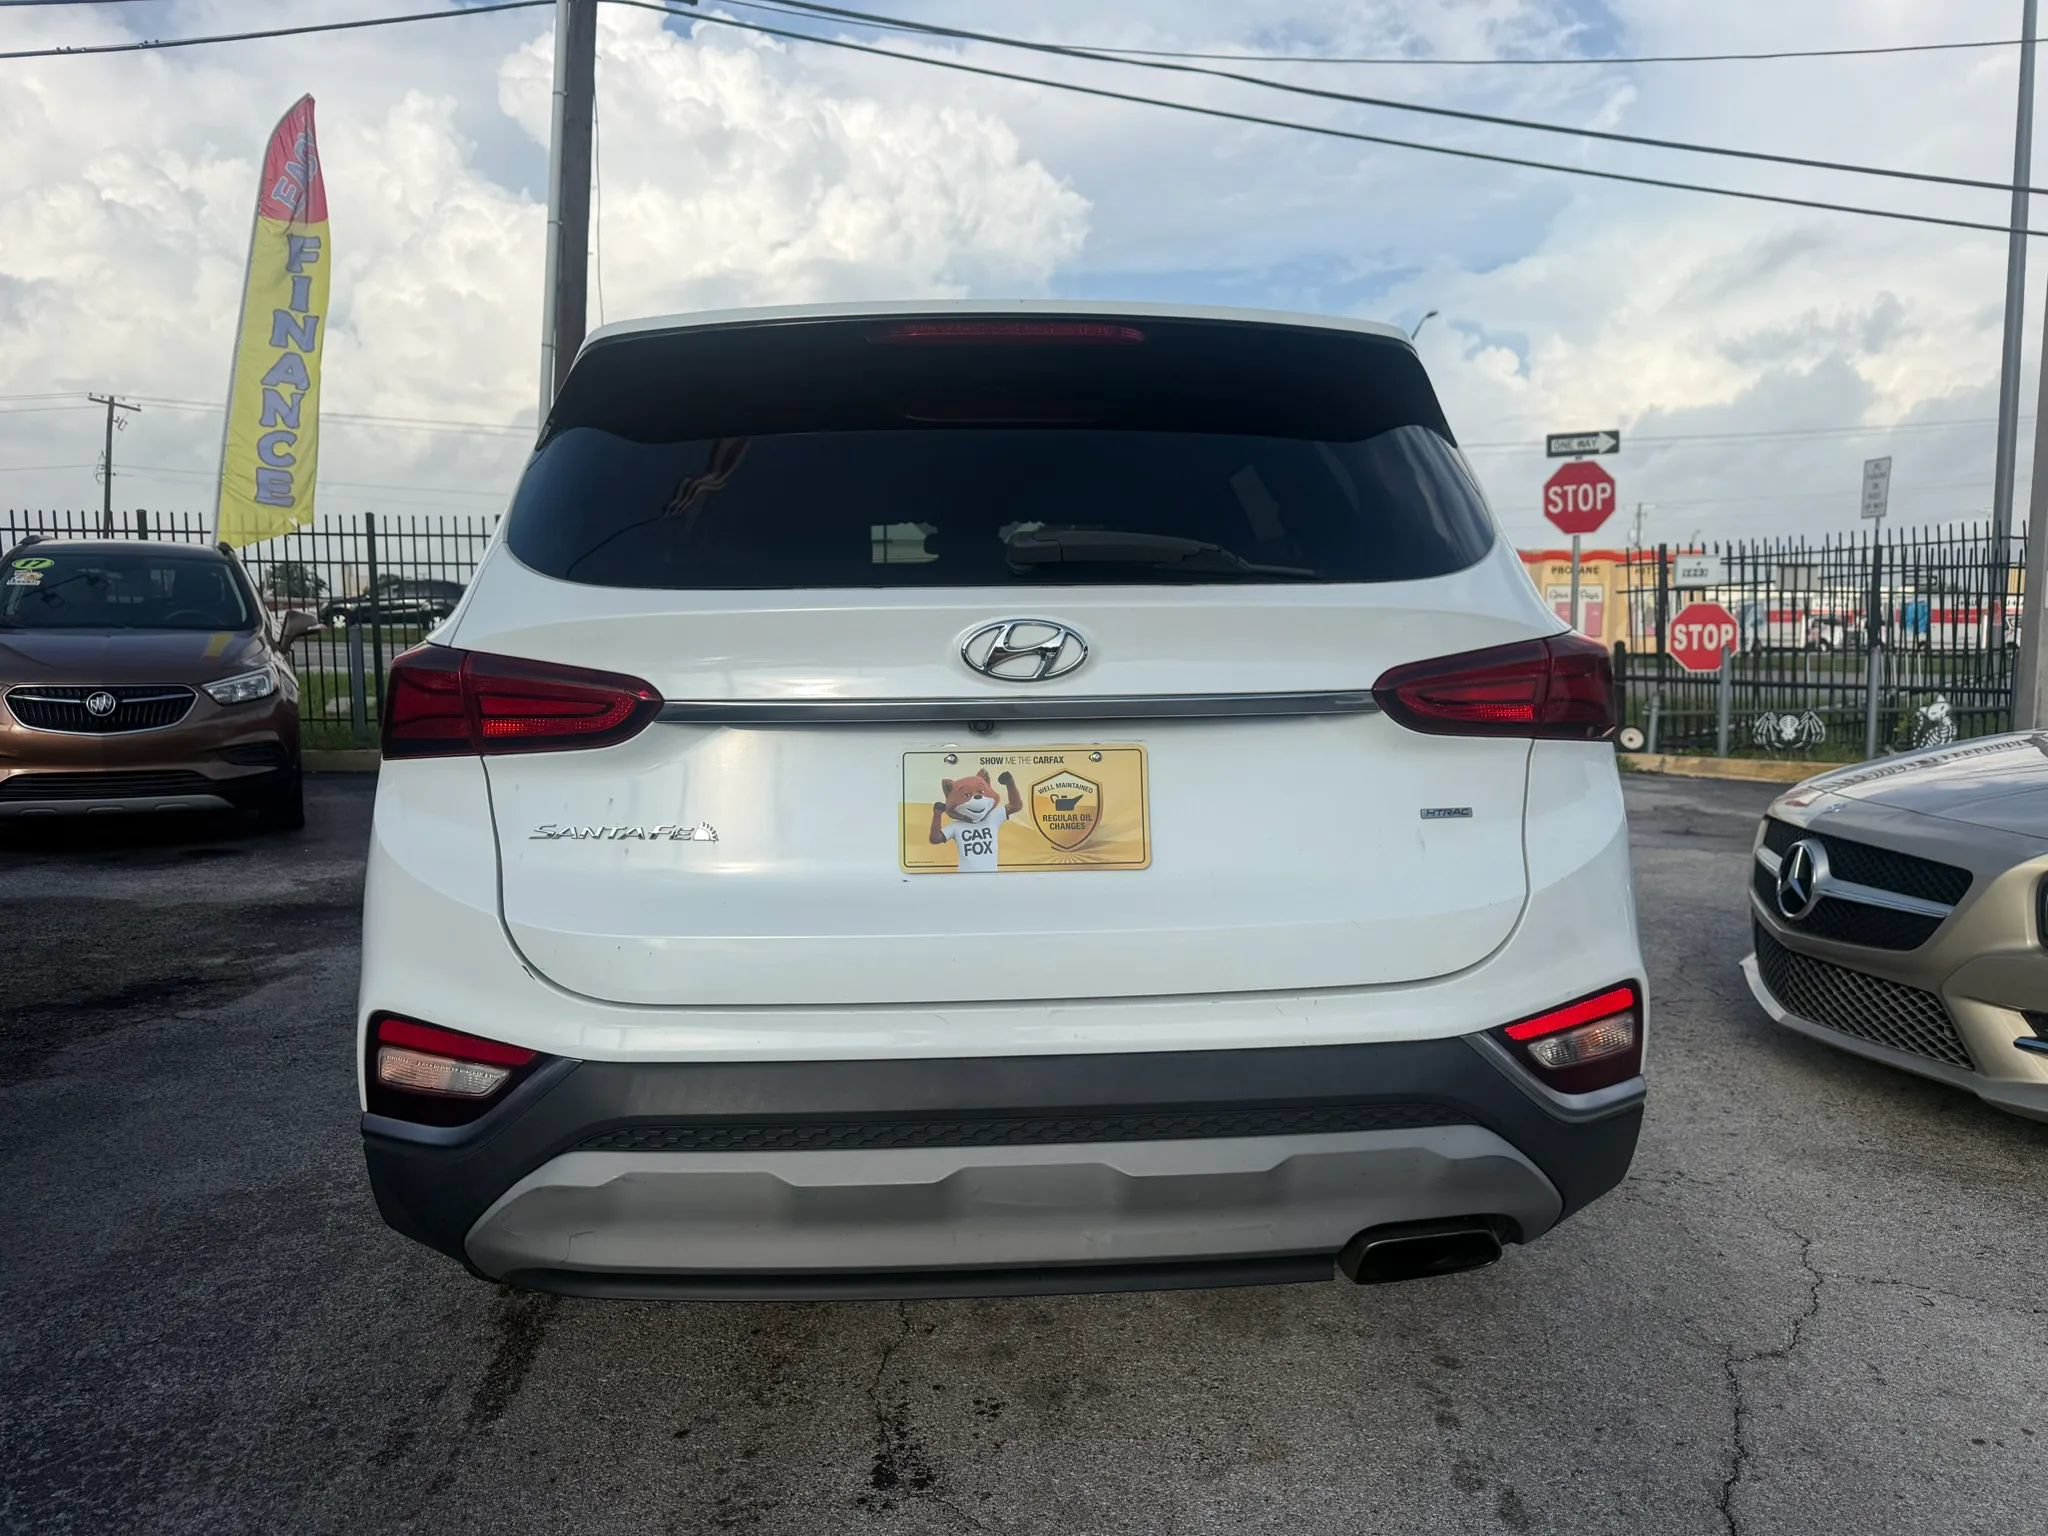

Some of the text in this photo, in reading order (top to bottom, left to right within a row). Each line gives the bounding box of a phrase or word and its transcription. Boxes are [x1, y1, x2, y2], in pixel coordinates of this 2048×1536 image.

[255, 233, 322, 508] FINANCE
[1553, 439, 1597, 450] ONE WAY
[1547, 482, 1612, 514] STOP
[1551, 565, 1600, 575] PROANE
[1673, 623, 1734, 651] STOP
[979, 755, 1065, 765] SHOW ME THE CARFAX
[1037, 782, 1094, 795] WELL MAINTAINED
[1042, 813, 1093, 822] REGULAR OIL
[1426, 808, 1470, 817] HTRAC
[529, 824, 696, 841] SANTA FE
[1050, 822, 1086, 831] CHANGES
[961, 827, 993, 842] CAR
[963, 840, 993, 857] FOX
